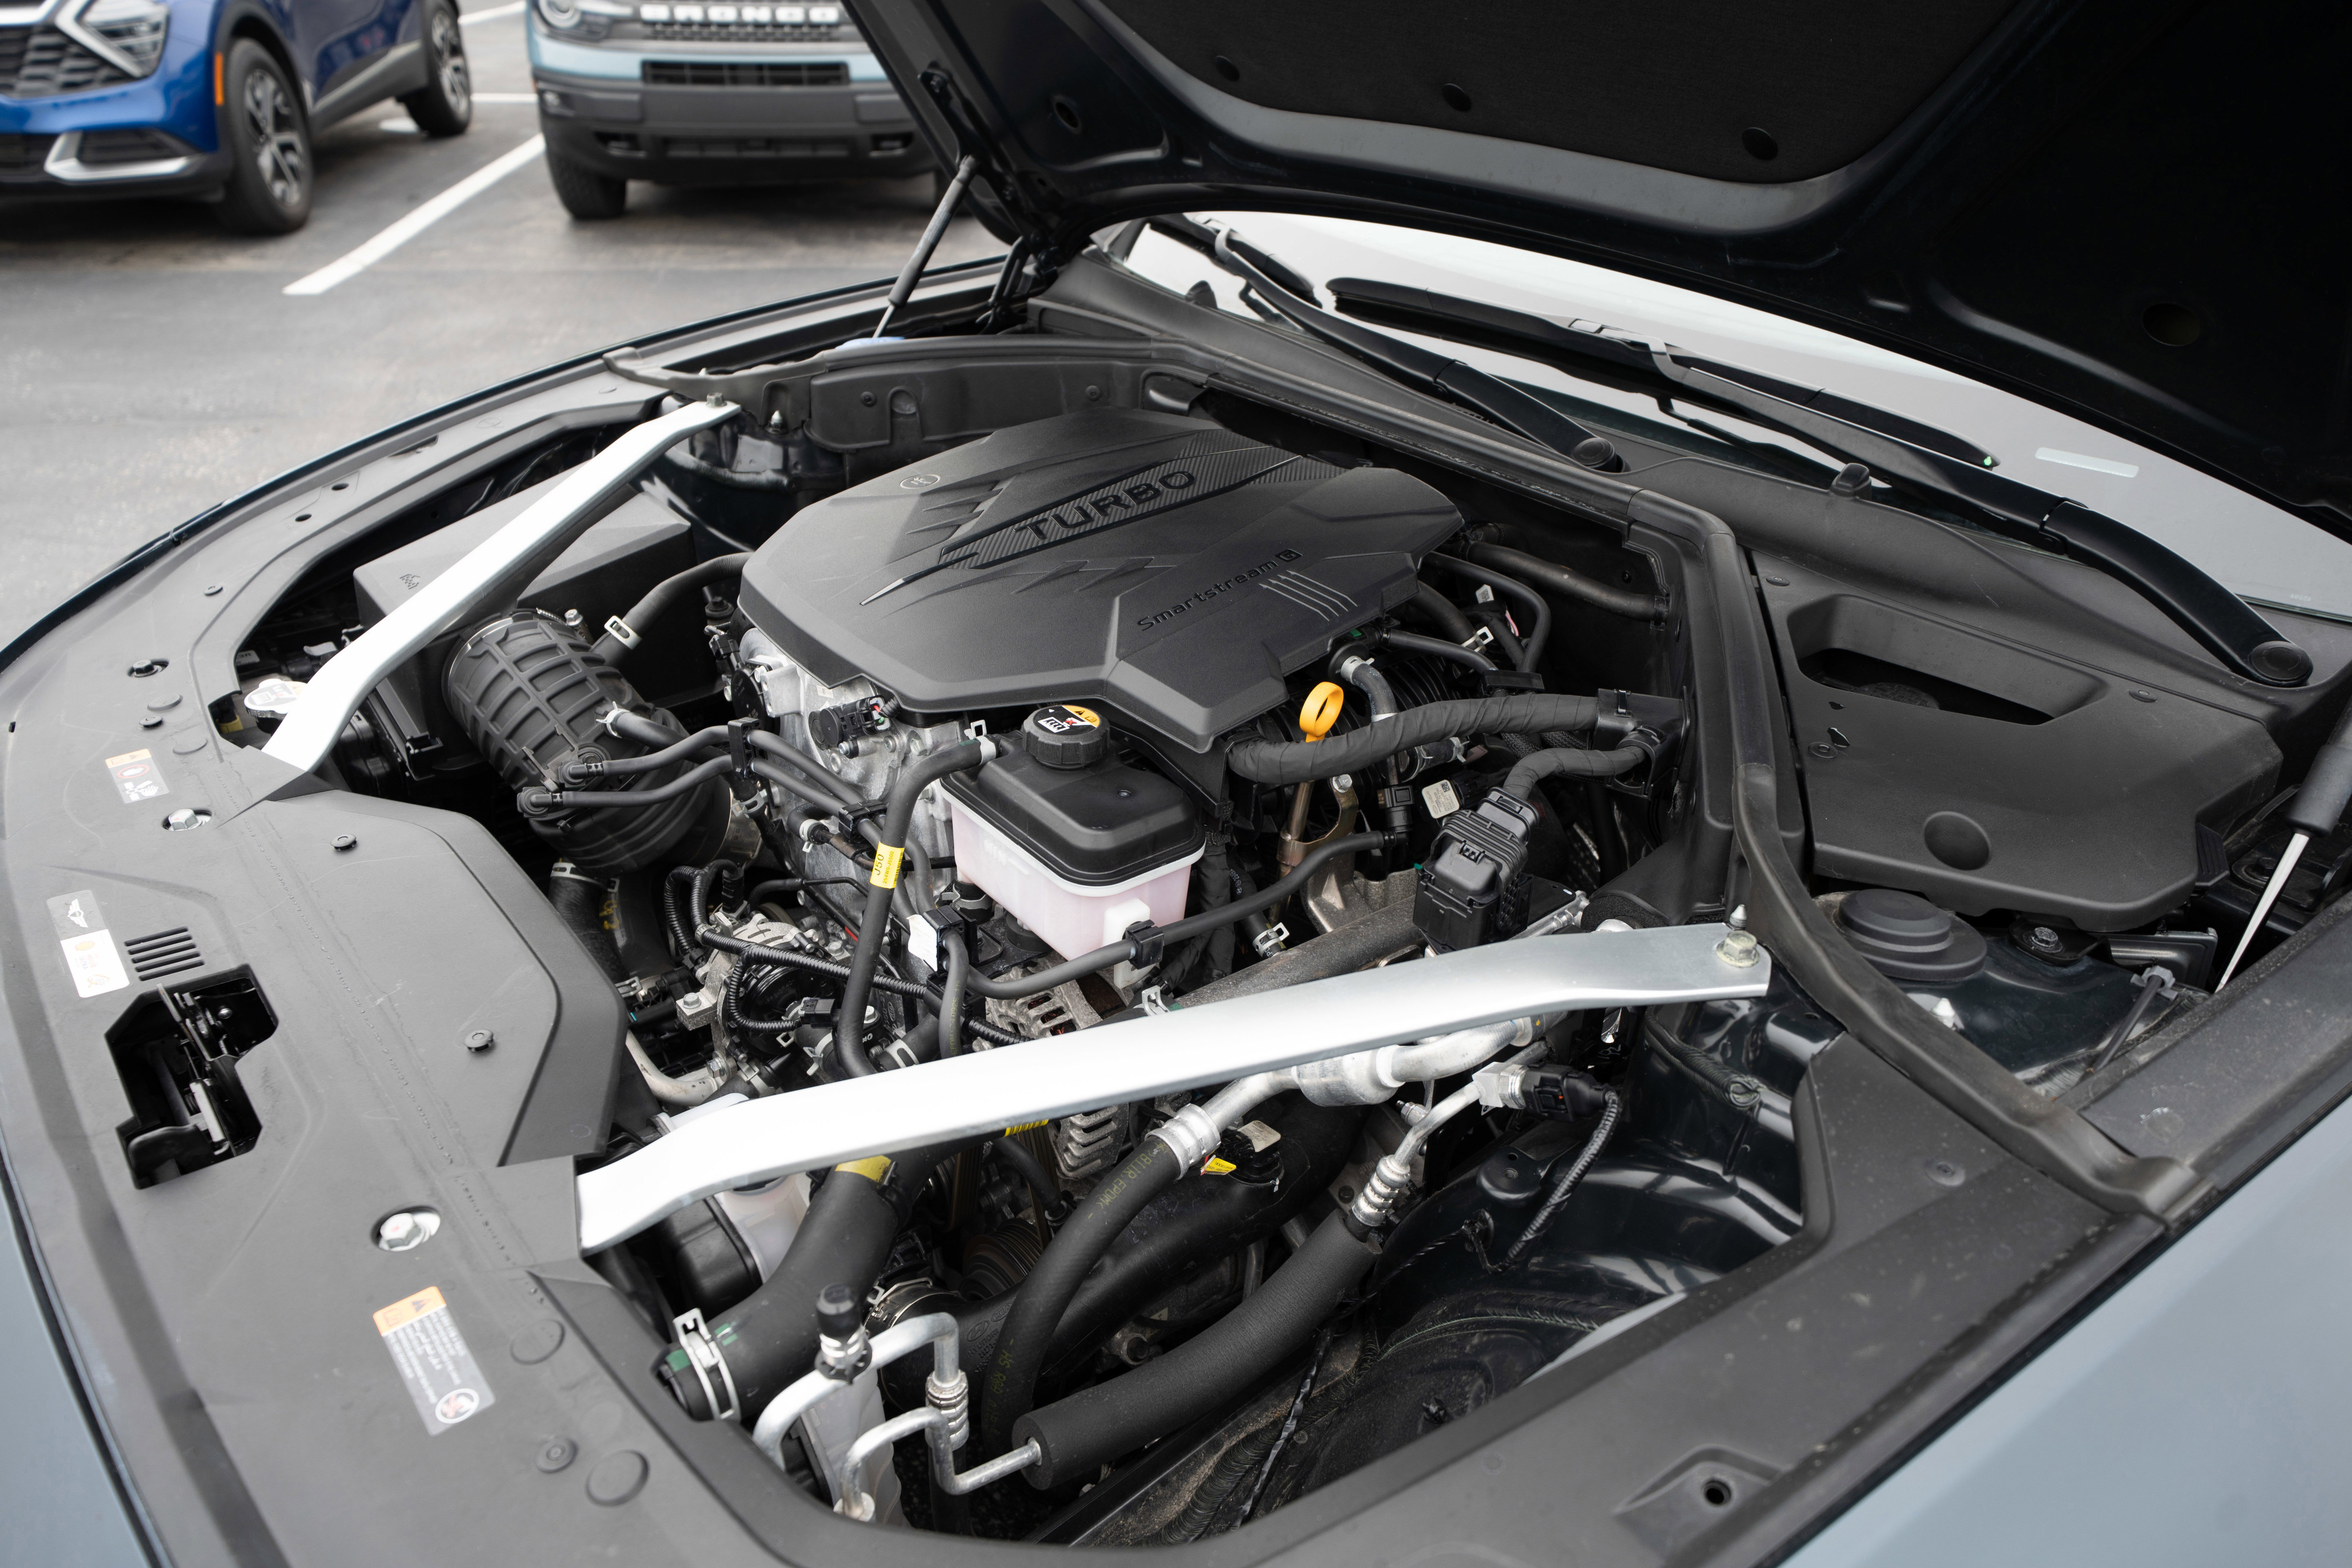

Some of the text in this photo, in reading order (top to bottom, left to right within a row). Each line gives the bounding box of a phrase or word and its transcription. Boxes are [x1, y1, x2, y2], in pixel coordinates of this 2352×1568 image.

[639, 3, 840, 24] BRONCO
[1013, 471, 1196, 540] TURBO
[1137, 559, 1278, 631] Smartstream
[875, 854, 884, 875] J50
[882, 851, 894, 884] 254W0-J5500
[79, 956, 89, 970] ULTRA
